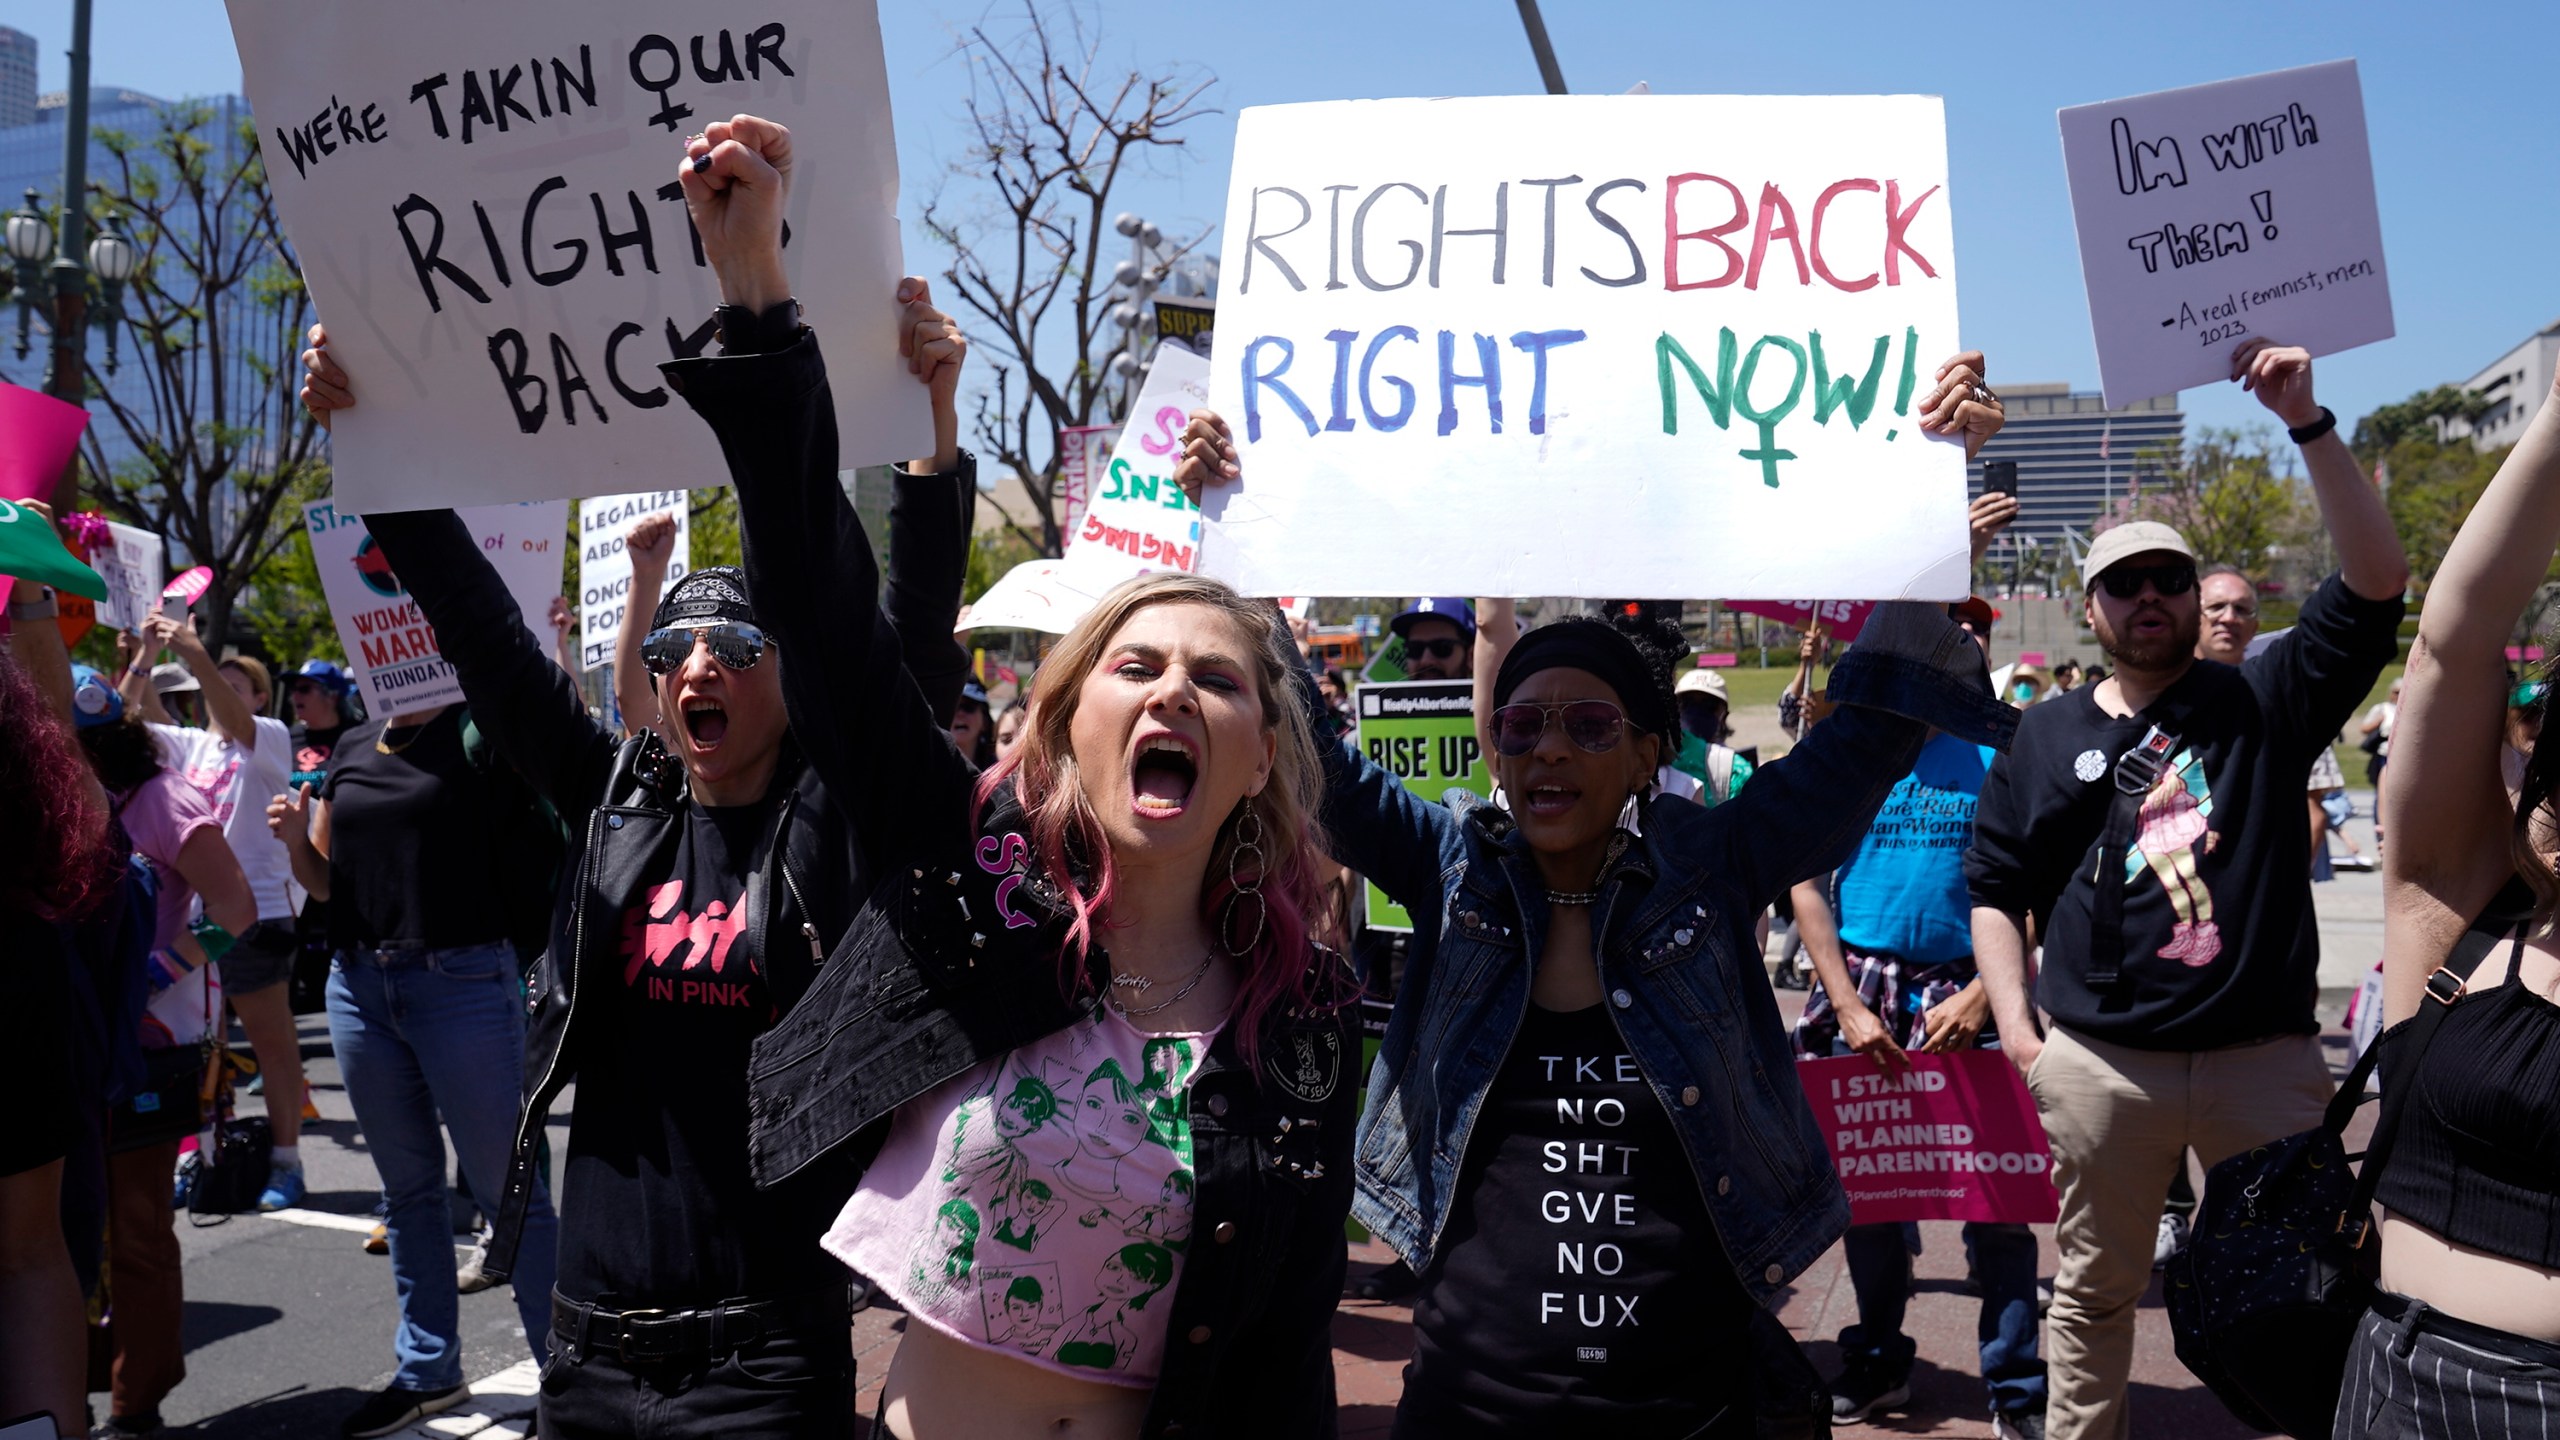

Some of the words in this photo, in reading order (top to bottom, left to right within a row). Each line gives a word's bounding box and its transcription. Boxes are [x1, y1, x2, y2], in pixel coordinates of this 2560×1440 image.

[276, 97, 388, 180] WE'RE
[410, 43, 597, 144] TAKIN
[629, 22, 795, 132] OUR
[392, 176, 791, 313] RIGHT
[1239, 174, 1647, 295] RIGHTS
[1663, 172, 1942, 292] BACK
[2201, 294, 2238, 323] real
[2241, 269, 2324, 310] feminist,
[2325, 257, 2376, 287] men
[1241, 325, 1588, 444] RIGHT
[1655, 325, 1917, 489] NOW!
[1101, 457, 1200, 512] EN'S
[584, 490, 683, 533] LEGALIZE
[484, 532, 506, 551] of
[1082, 515, 1198, 574] NGING
[352, 600, 429, 636] WOME
[359, 625, 440, 669] MARC
[371, 659, 457, 693] FOUNDATI
[1383, 695, 1474, 714] RiseUp4AbortionRig
[1369, 737, 1430, 779] RISE
[1439, 736, 1483, 780] UP
[1881, 801, 1912, 817] ore
[1914, 796, 1977, 819] Right
[648, 977, 674, 1001] IN
[682, 981, 751, 1008] PINK
[1539, 1055, 1640, 1082] TKE
[1831, 1078, 1841, 1100] I
[1848, 1071, 1946, 1098] STAND
[1557, 1098, 1626, 1127] NO
[1834, 1098, 1912, 1125] WITH
[1836, 1124, 1975, 1152] PLANNED
[1542, 1141, 1640, 1175] SHT
[1839, 1151, 2048, 1178] PARENTHOOD
[1541, 1191, 1636, 1225] GVE
[1854, 1189, 1897, 1202] Planned
[1899, 1187, 1966, 1199] Parenthood
[1558, 1242, 1624, 1275] NO
[1541, 1293, 1640, 1327] FUX
